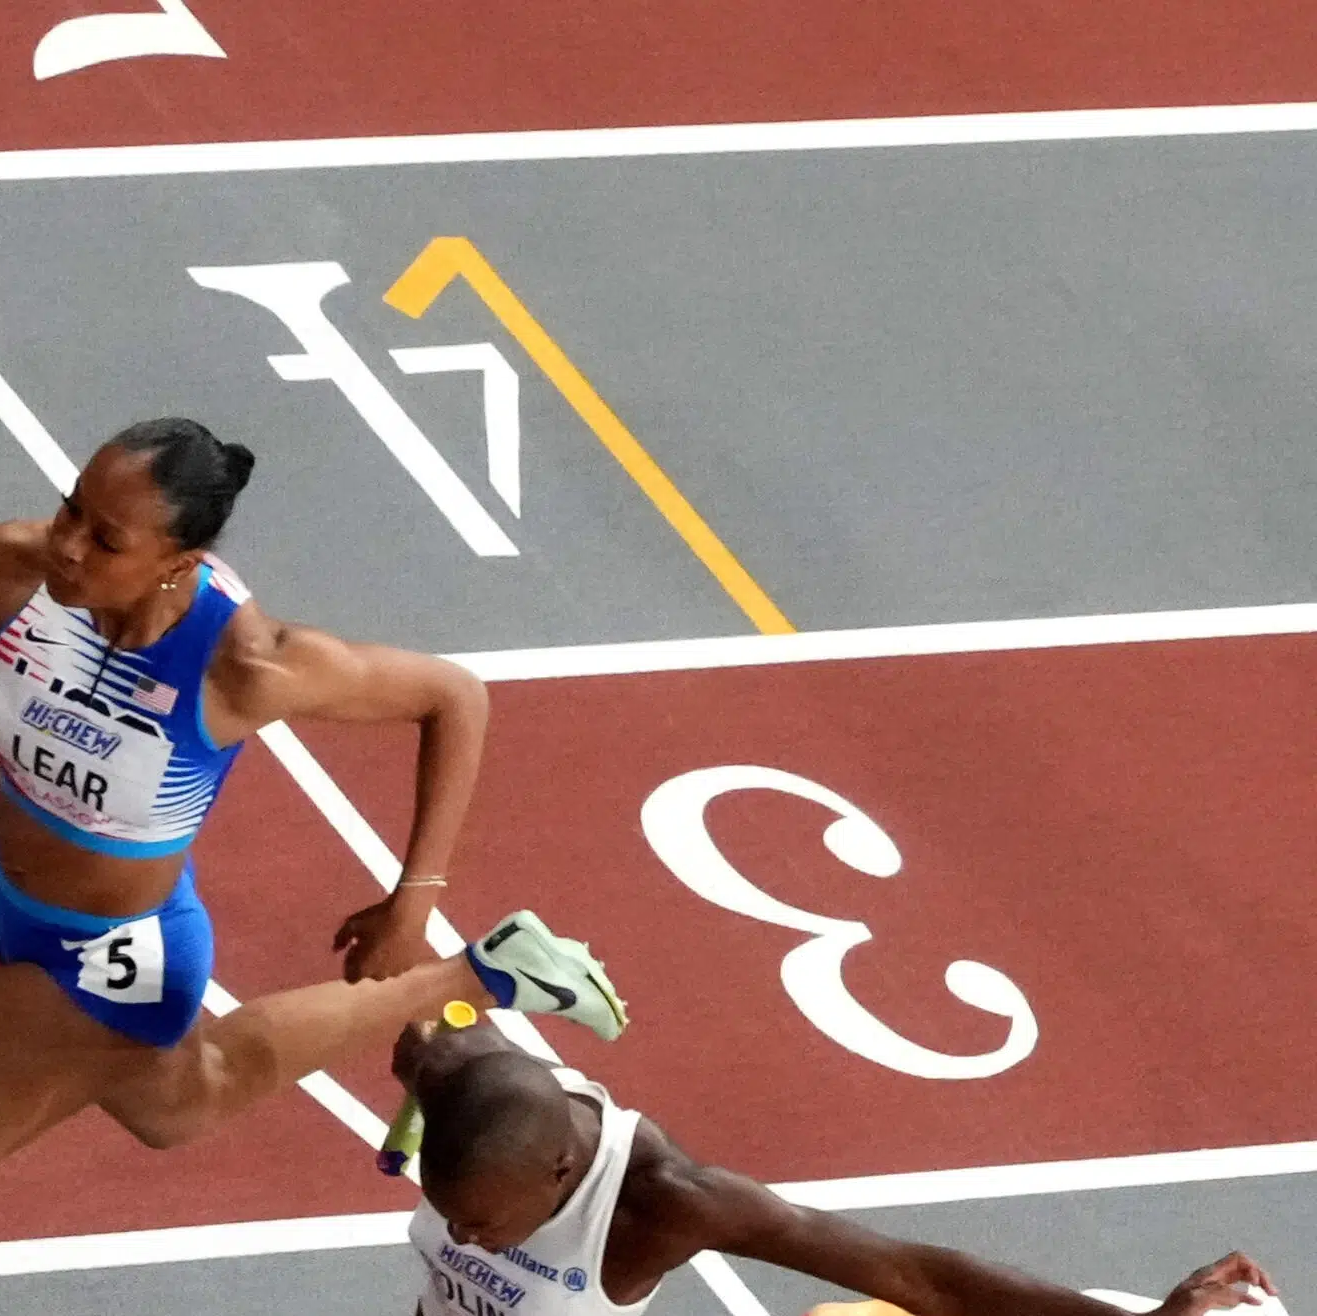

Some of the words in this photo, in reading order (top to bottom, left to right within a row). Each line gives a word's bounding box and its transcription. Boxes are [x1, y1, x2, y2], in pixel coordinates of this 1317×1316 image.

[187, 262, 521, 557] 4
[12, 734, 109, 812] LEAR
[107, 938, 137, 990] 5
[641, 764, 1039, 1081] 3
